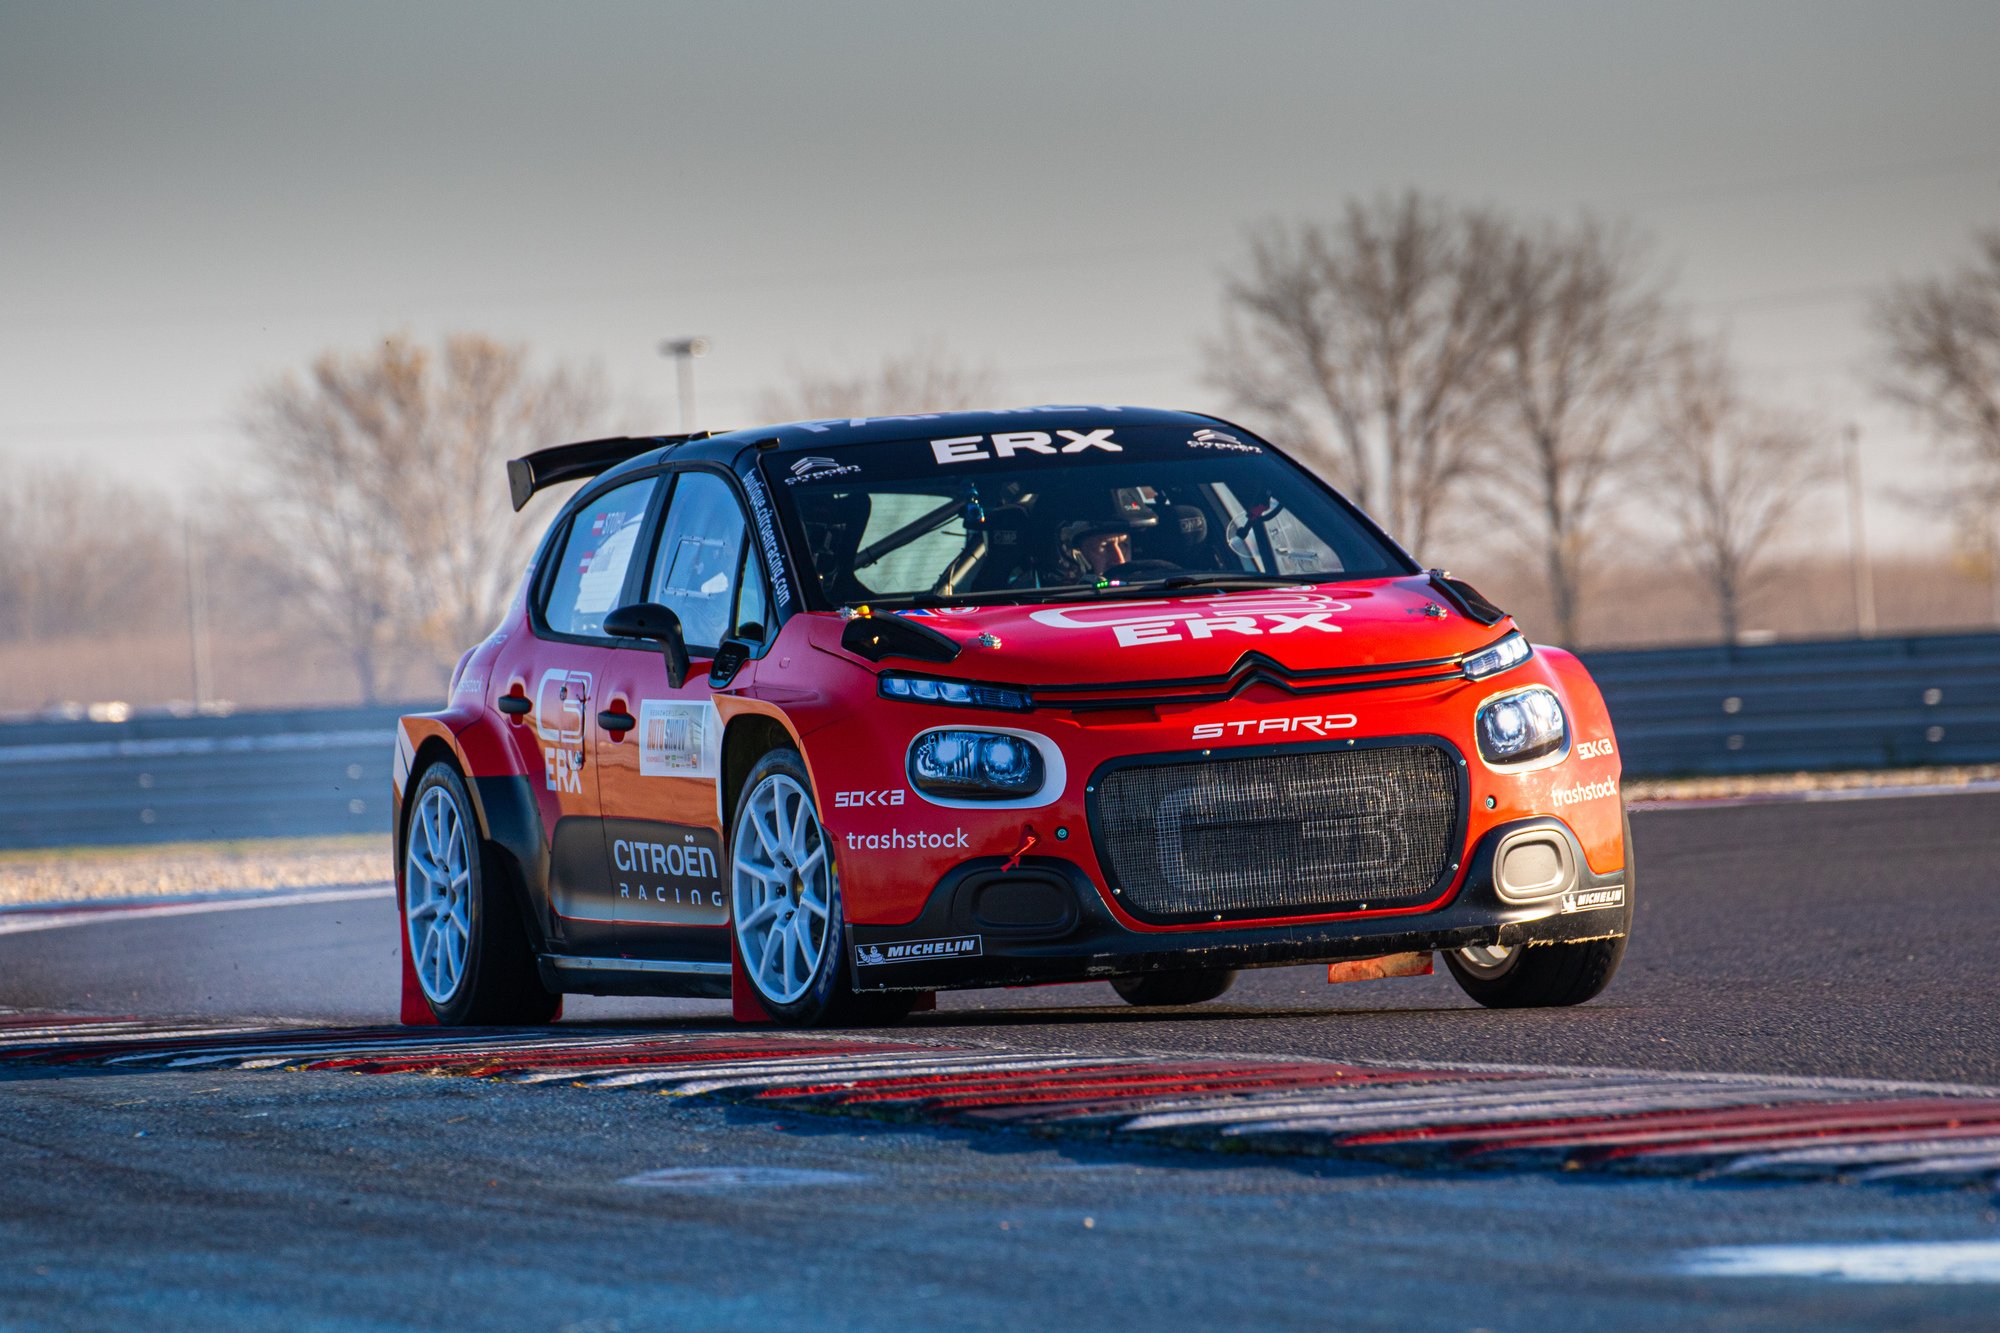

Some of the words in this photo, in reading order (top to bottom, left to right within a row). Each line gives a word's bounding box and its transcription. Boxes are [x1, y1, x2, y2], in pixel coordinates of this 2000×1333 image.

[930, 428, 1123, 464] ERX
[742, 467, 791, 608] boutique.citroenracing.com
[1112, 613, 1343, 648] ERX
[1191, 713, 1358, 740] STARD
[545, 747, 582, 794] ERX
[1551, 775, 1617, 807] trashstock
[846, 827, 970, 850] trashstock
[613, 834, 718, 878] CITROËN
[620, 882, 723, 907] RACING
[1577, 889, 1622, 906] MICHELIN
[887, 939, 976, 958] MICHELIN
